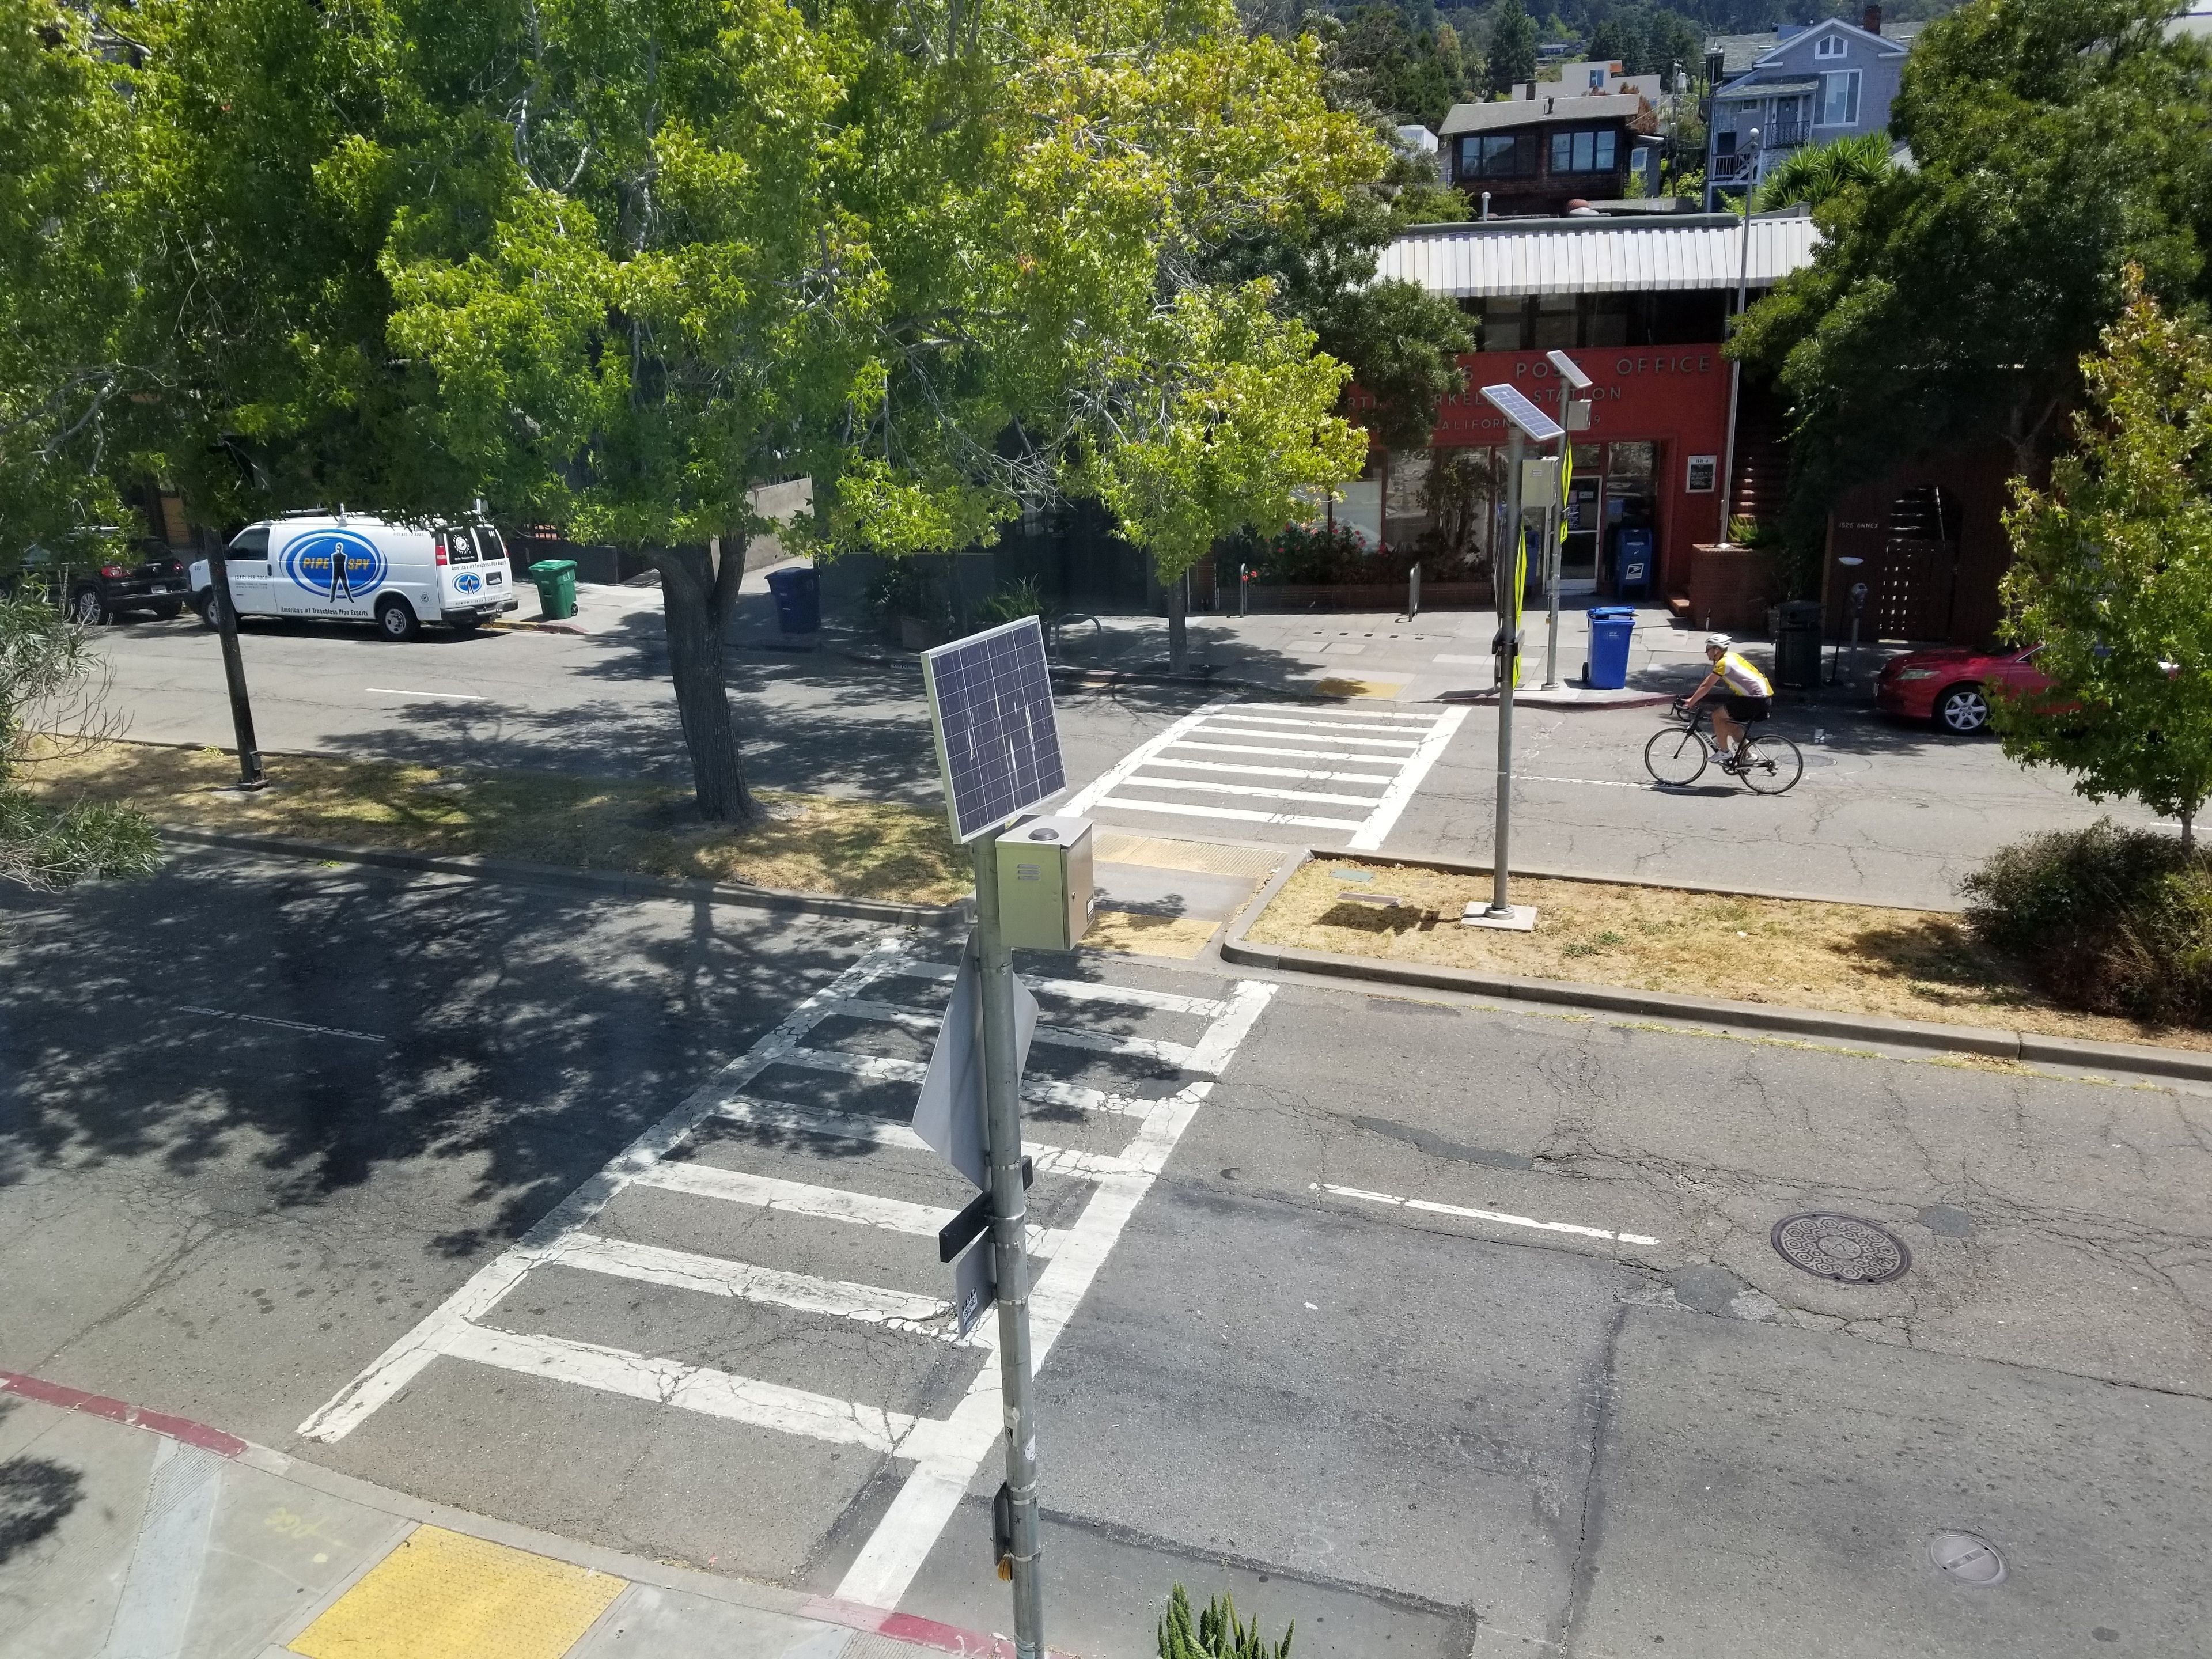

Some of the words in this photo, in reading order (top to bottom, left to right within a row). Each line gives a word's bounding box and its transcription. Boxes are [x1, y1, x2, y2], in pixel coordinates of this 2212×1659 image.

[1516, 359, 1583, 379] POS
[1616, 355, 1710, 375] OFFICE
[303, 557, 330, 569] PIPE
[347, 558, 370, 570] SPY
